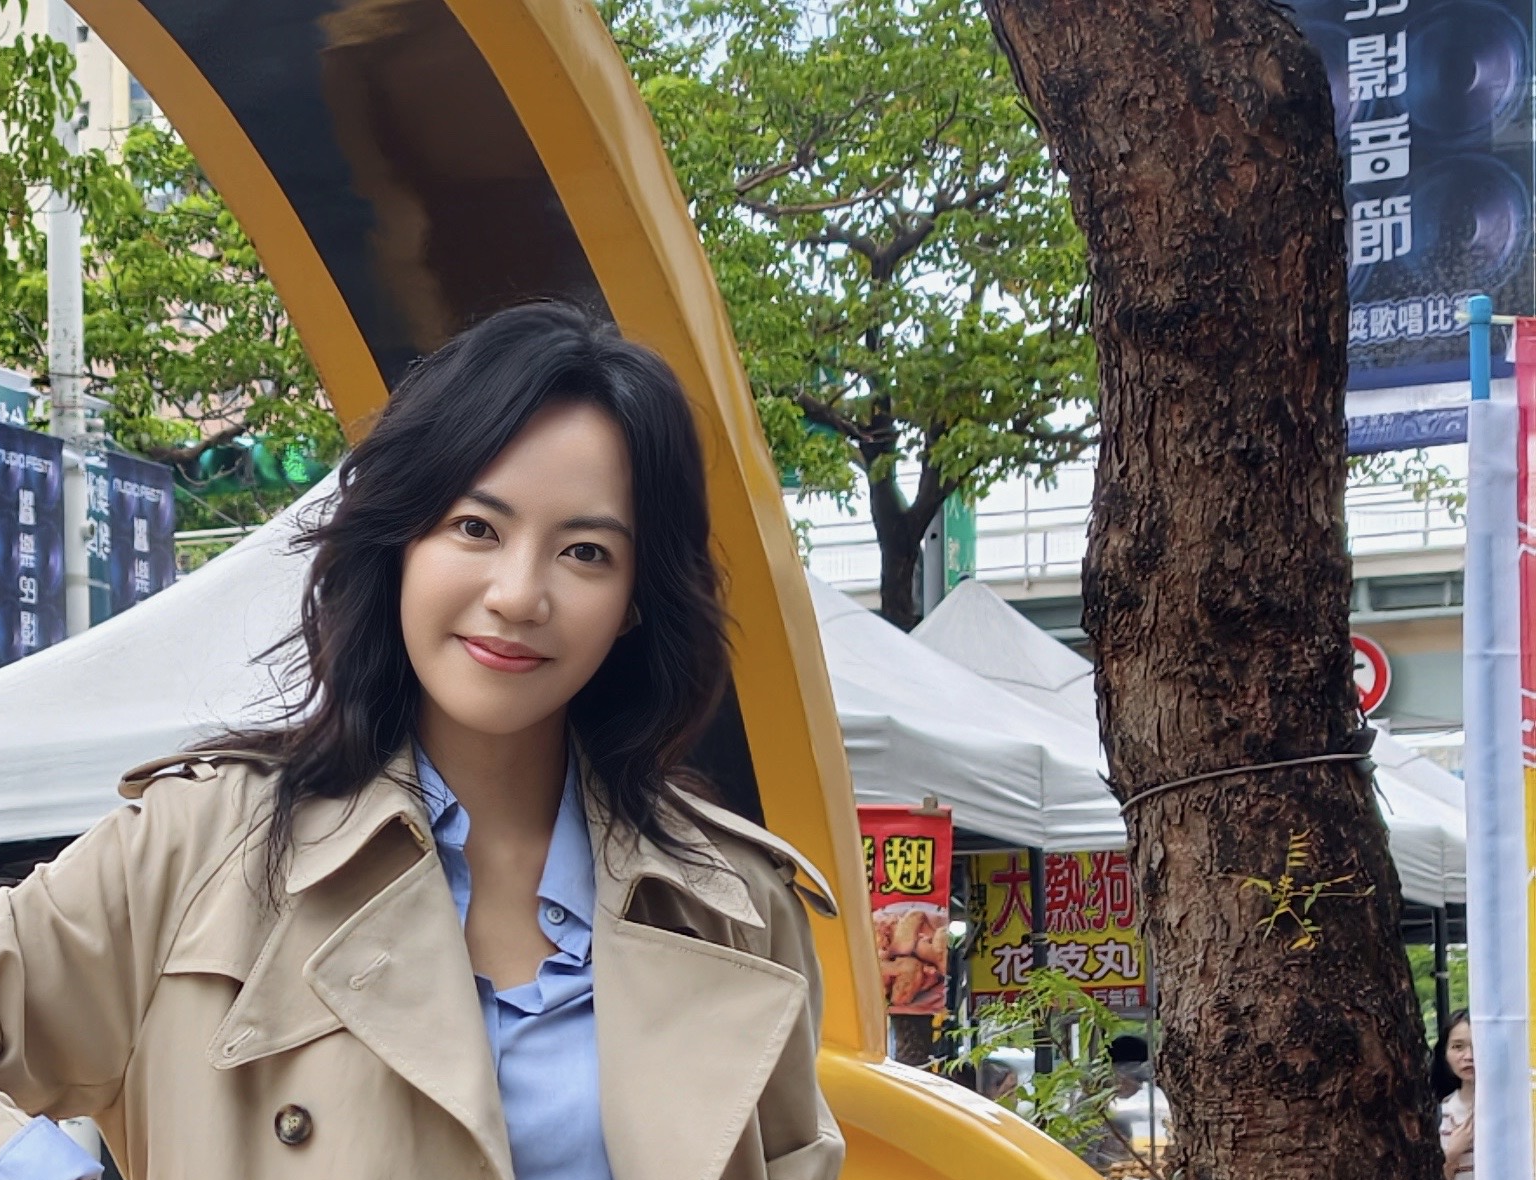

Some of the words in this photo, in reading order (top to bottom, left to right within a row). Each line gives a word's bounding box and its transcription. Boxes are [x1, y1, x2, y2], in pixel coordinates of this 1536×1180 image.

[862, 836, 935, 896] 翅
[990, 850, 1138, 937] 大熱狗
